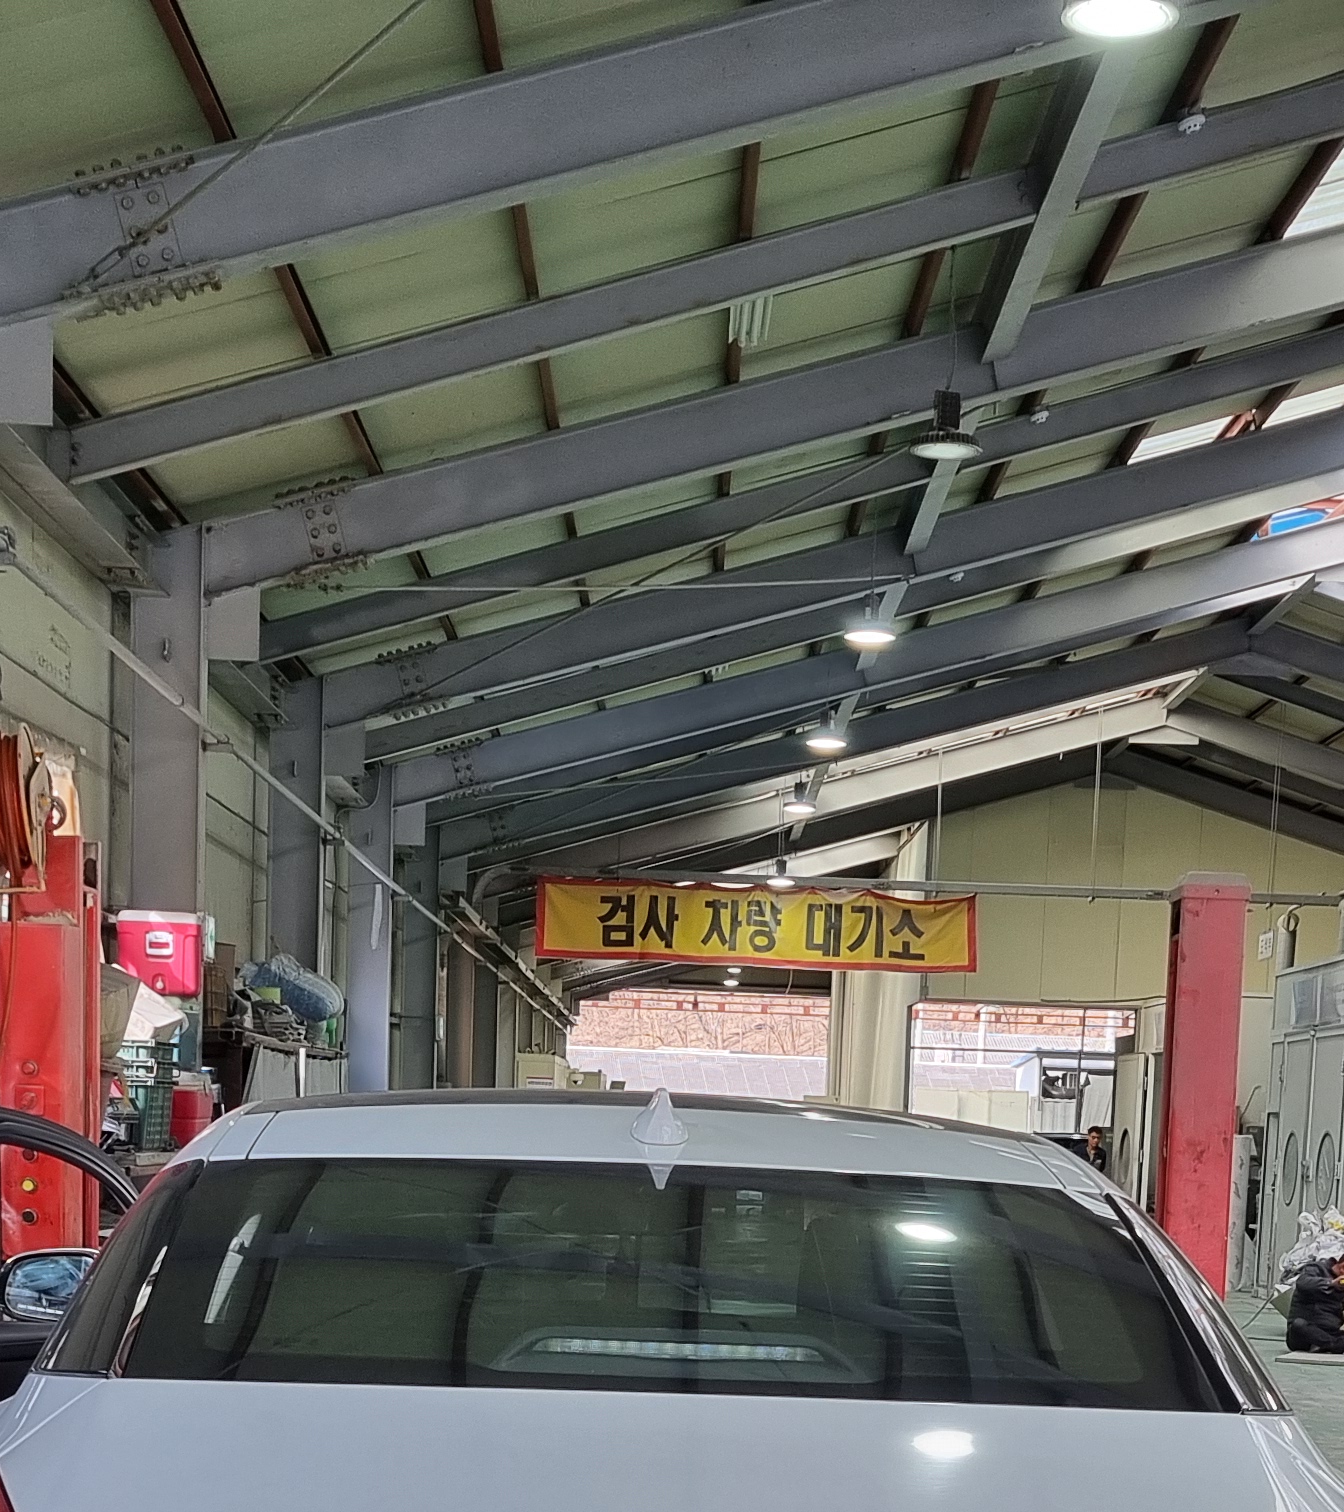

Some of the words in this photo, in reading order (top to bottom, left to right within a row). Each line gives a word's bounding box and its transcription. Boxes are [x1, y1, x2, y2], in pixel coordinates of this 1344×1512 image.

[596, 893, 679, 949] 검사
[700, 897, 783, 954] 차량
[804, 902, 926, 962] 대기소
